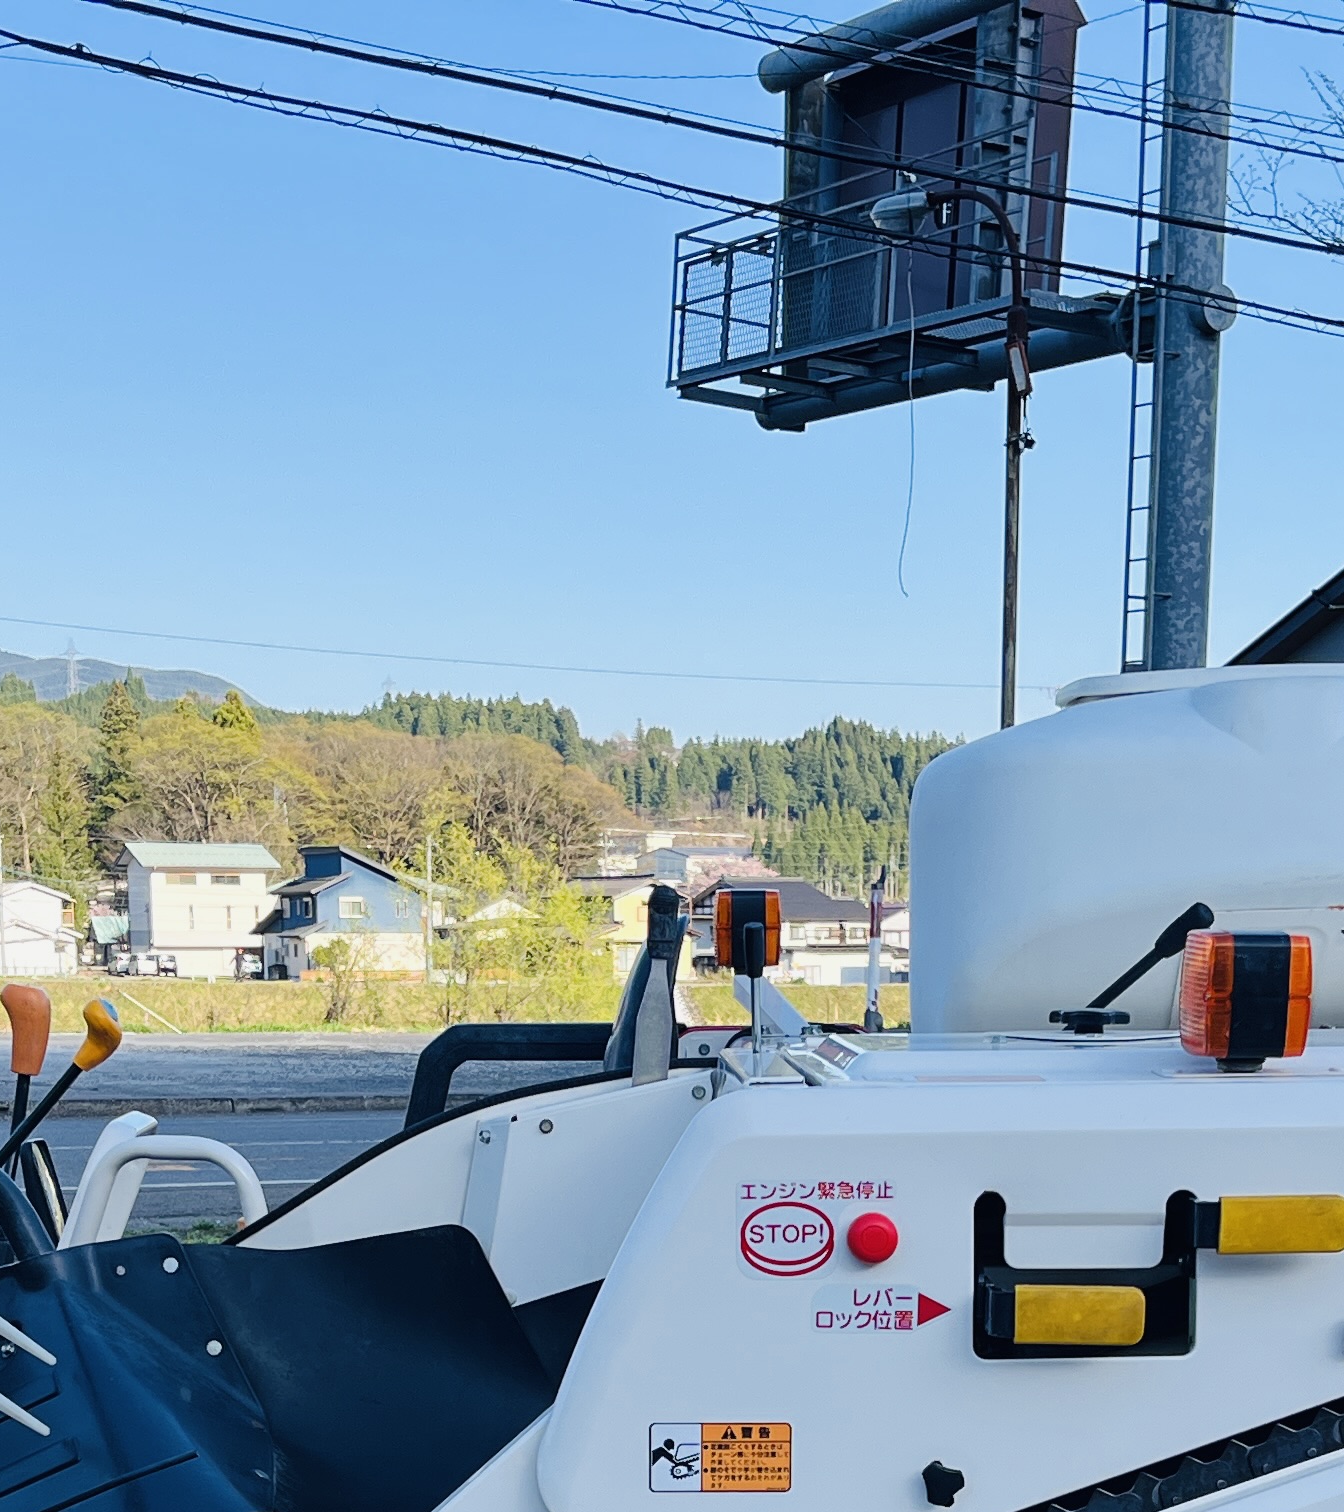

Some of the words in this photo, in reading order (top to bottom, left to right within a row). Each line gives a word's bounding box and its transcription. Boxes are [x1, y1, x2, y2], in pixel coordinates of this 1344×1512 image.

[741, 1181, 894, 1200] エンジン緊急停止
[749, 1224, 825, 1245] STOP!
[853, 1288, 913, 1307] レバー
[816, 1310, 914, 1331] ロック位置
